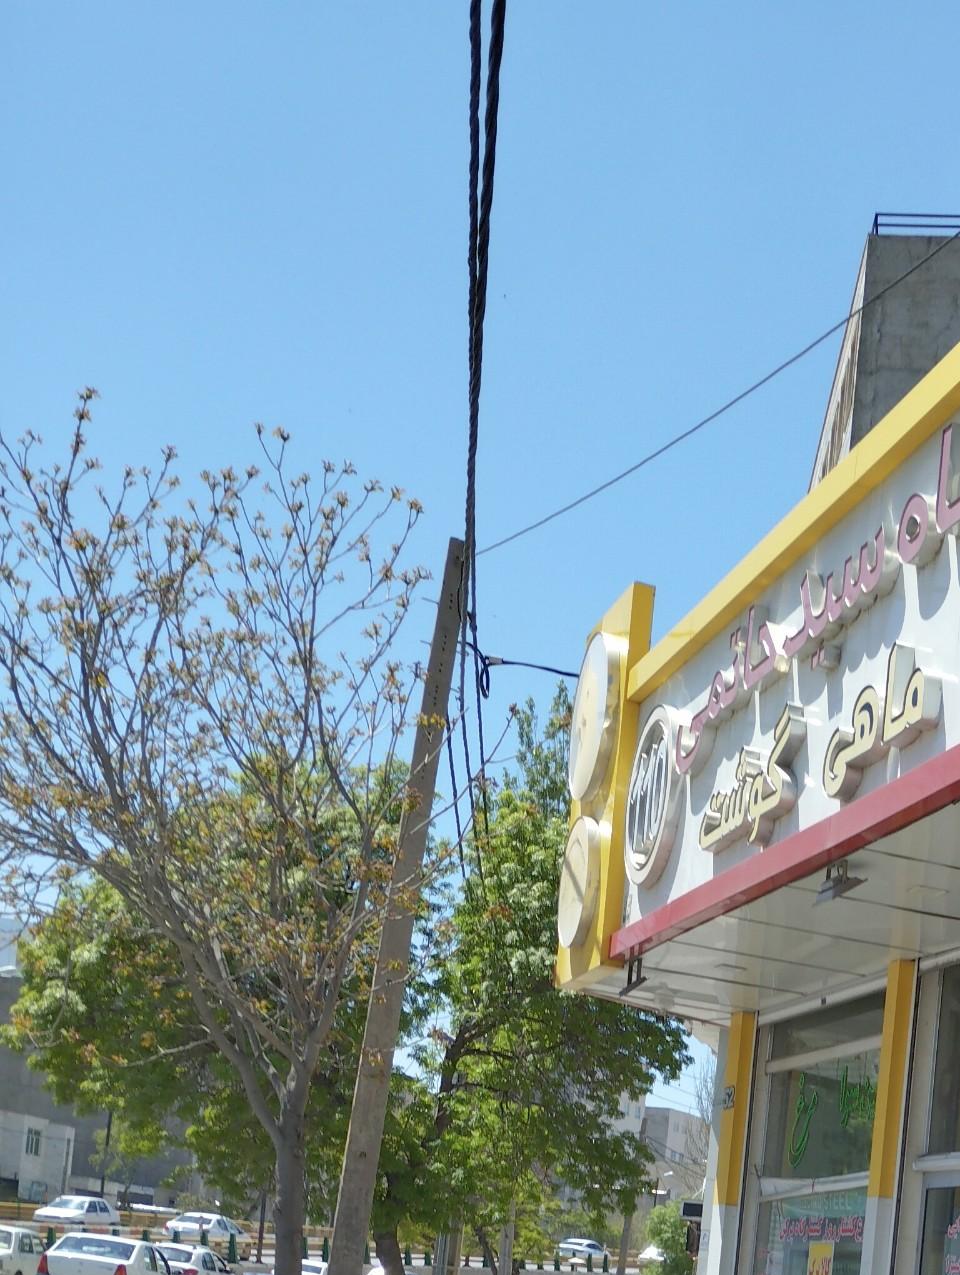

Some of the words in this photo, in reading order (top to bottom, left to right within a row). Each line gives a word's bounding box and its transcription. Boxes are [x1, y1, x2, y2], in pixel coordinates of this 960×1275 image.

[782, 525, 892, 672] سید
[699, 702, 804, 854] گوشت
[822, 641, 936, 800] ماهی
